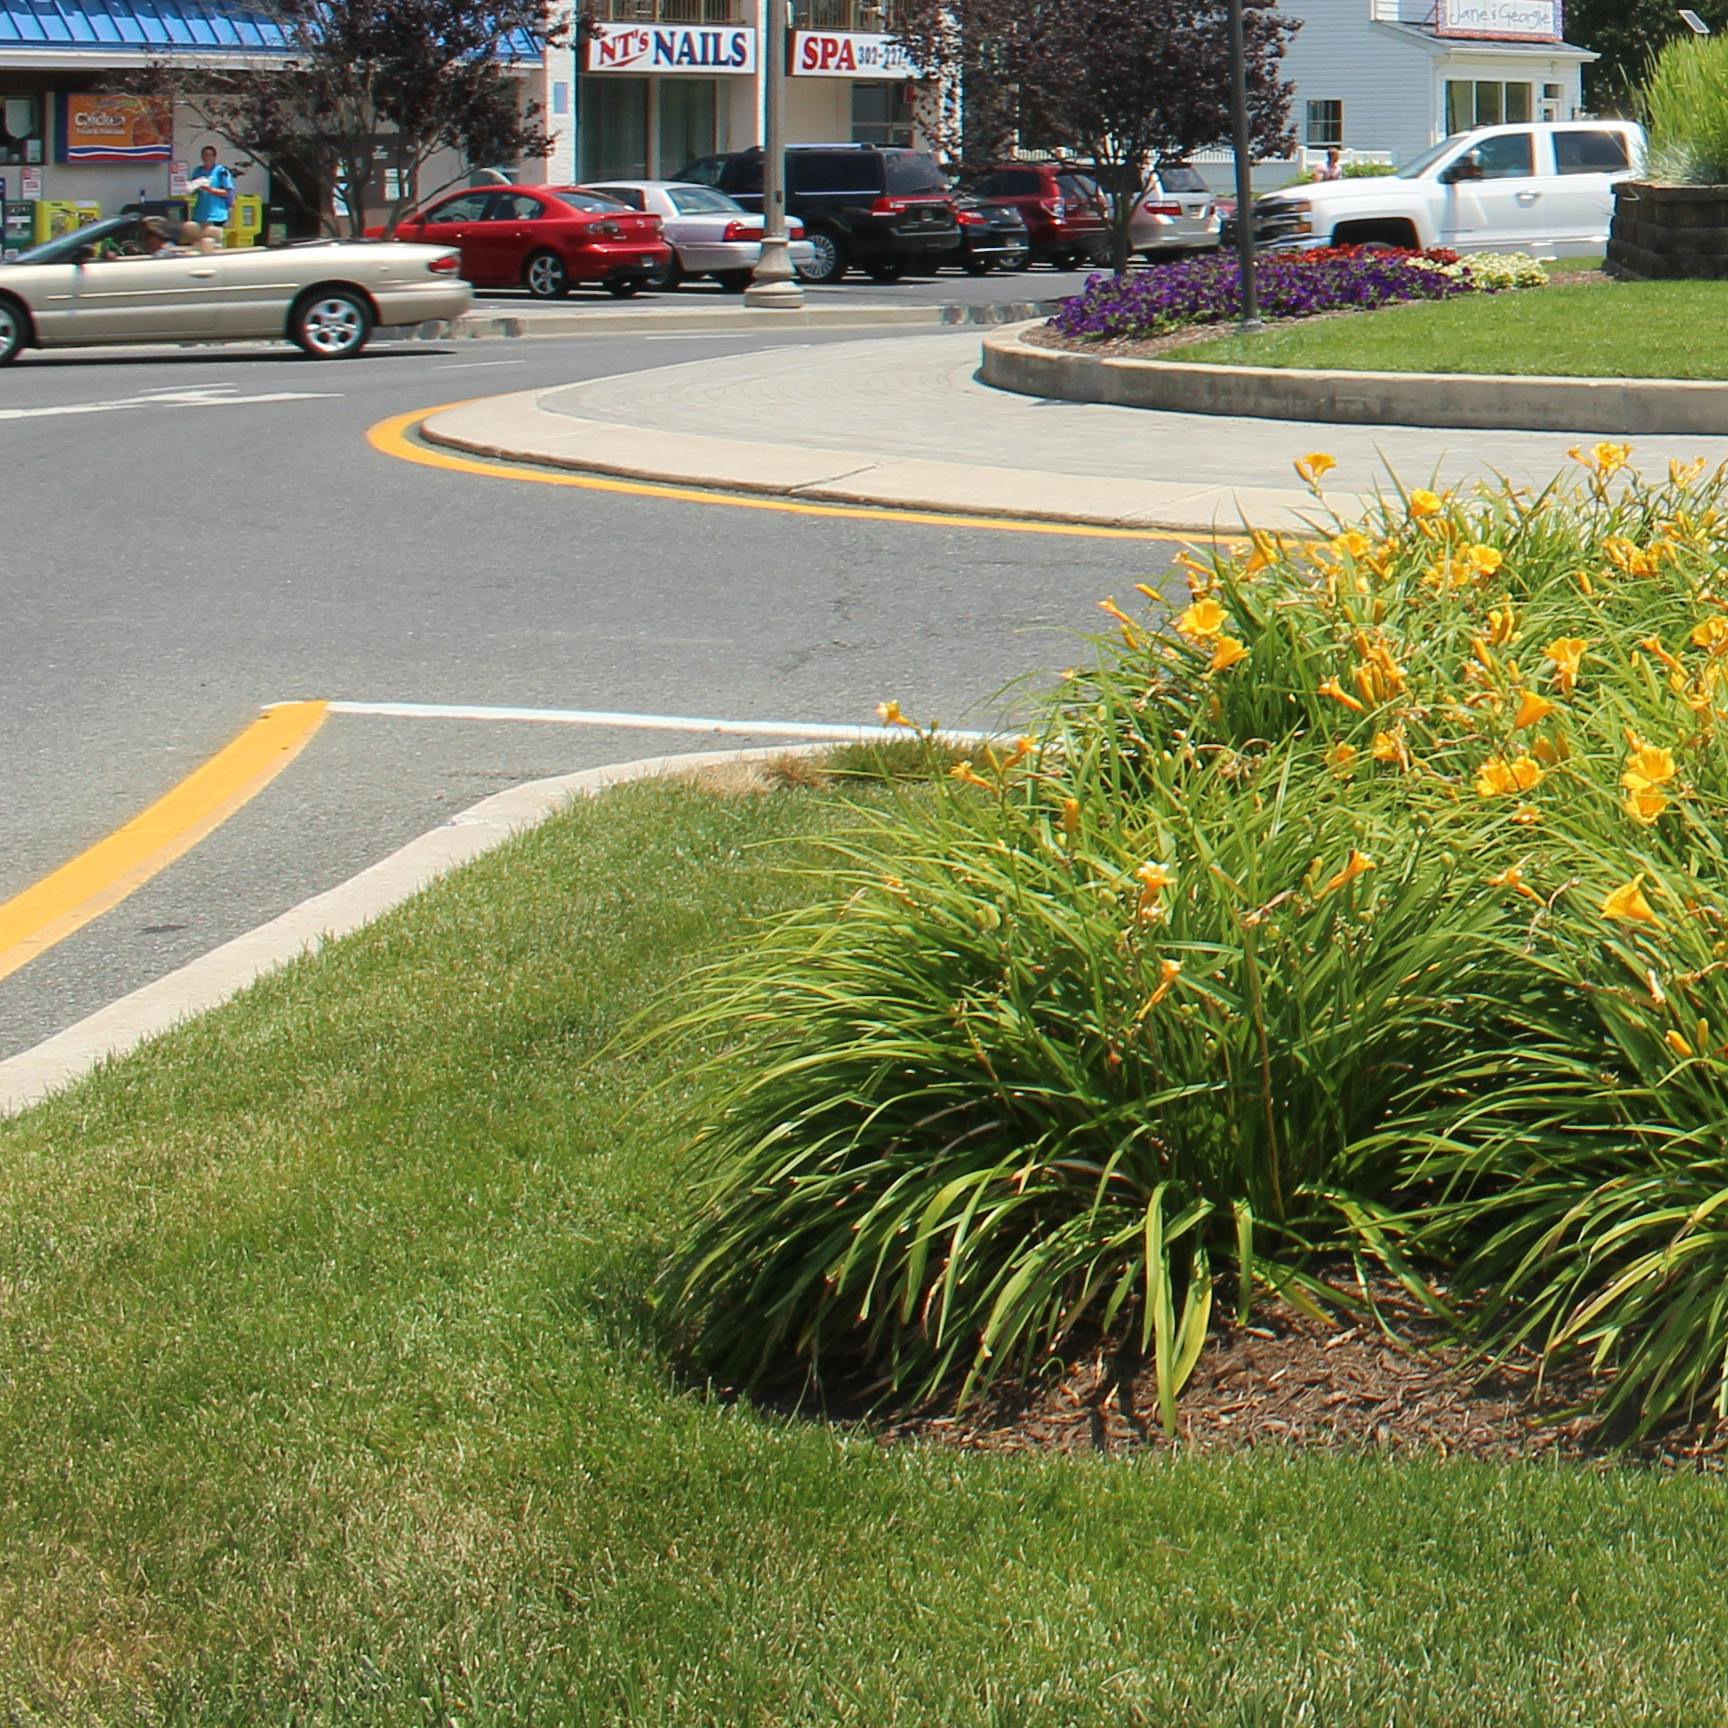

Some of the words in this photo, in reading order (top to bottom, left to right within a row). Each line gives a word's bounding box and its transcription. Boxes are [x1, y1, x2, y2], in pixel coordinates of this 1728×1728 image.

[1448, 0, 1488, 26] Jane
[652, 30, 748, 68] NAILS
[801, 36, 857, 71] SPA
